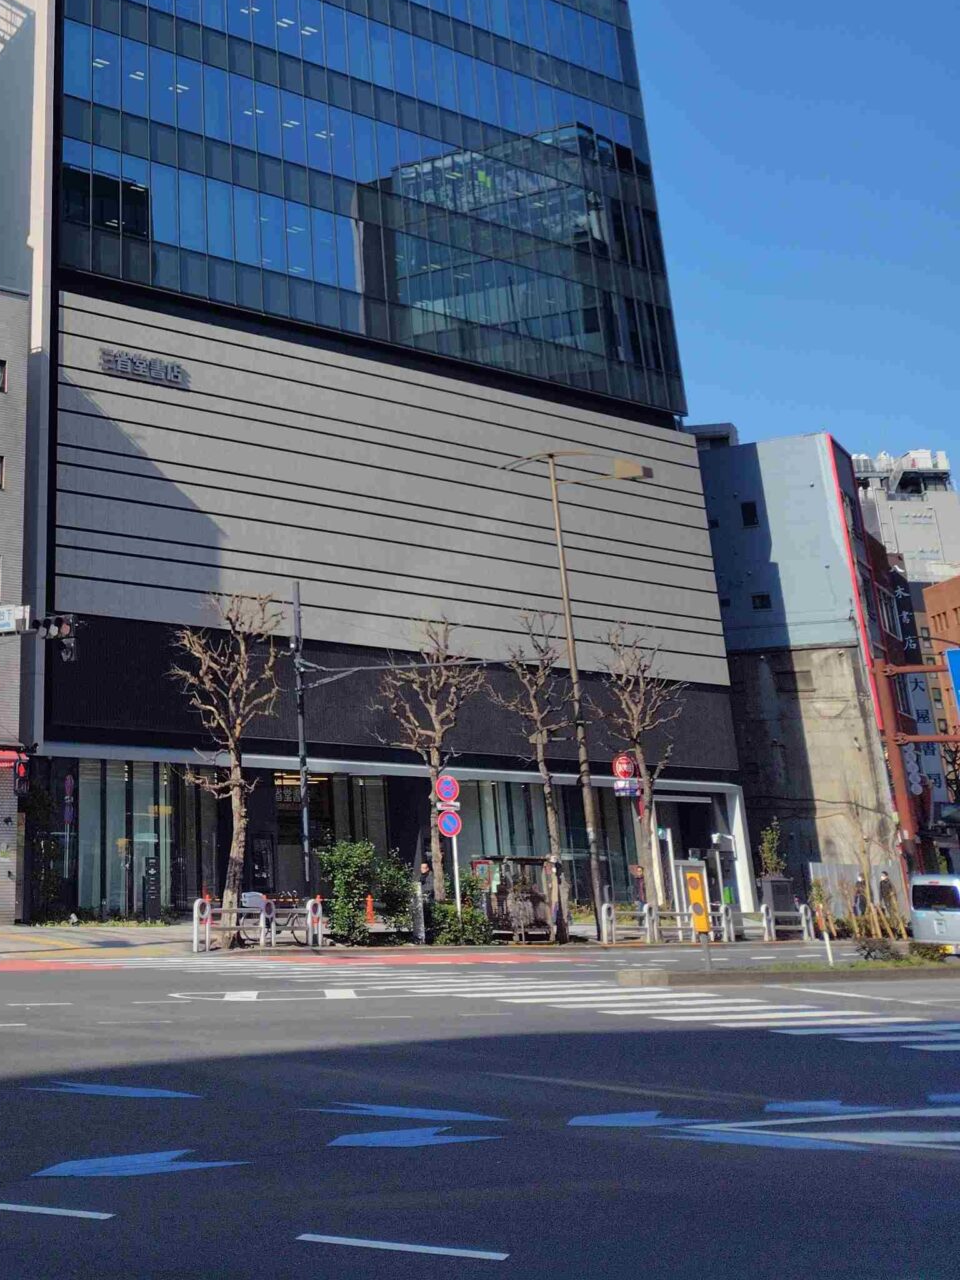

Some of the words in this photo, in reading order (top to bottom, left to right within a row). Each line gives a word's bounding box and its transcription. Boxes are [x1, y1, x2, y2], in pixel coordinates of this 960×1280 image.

[99, 348, 183, 383] 三省堂書店
[889, 563, 918, 652] 八木書店
